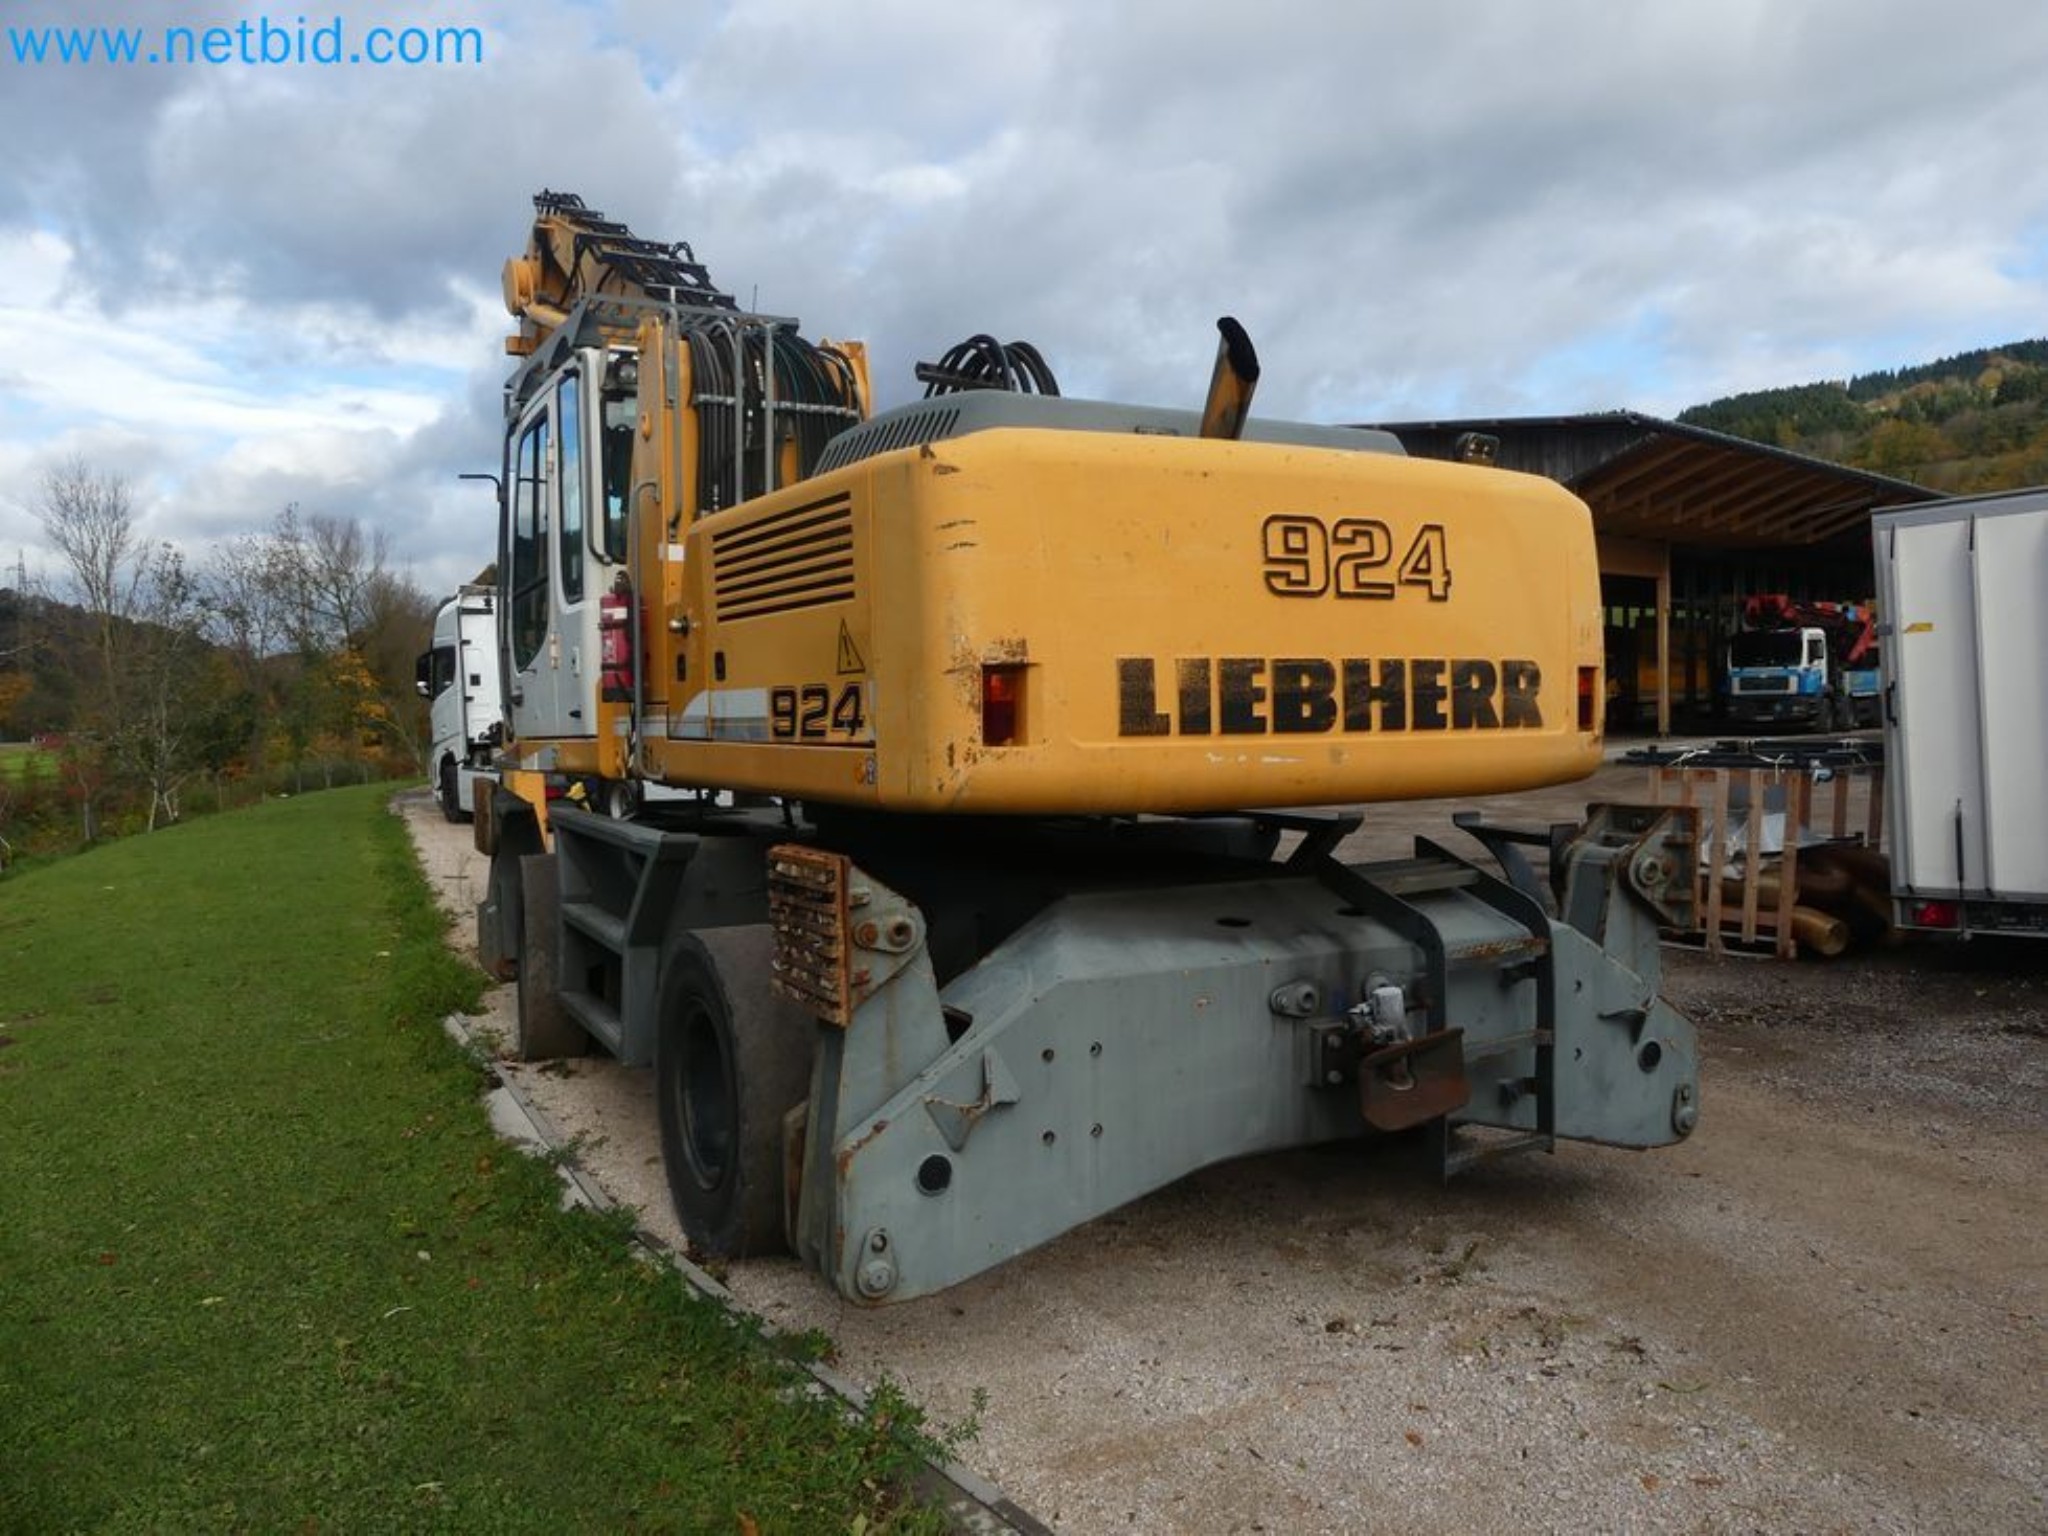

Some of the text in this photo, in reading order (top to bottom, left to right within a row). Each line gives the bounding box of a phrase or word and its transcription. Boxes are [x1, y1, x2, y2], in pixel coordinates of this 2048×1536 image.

[1261, 514, 1452, 602] 924
[771, 683, 865, 739] 924
[1116, 657, 1544, 737] LIEBHERR
